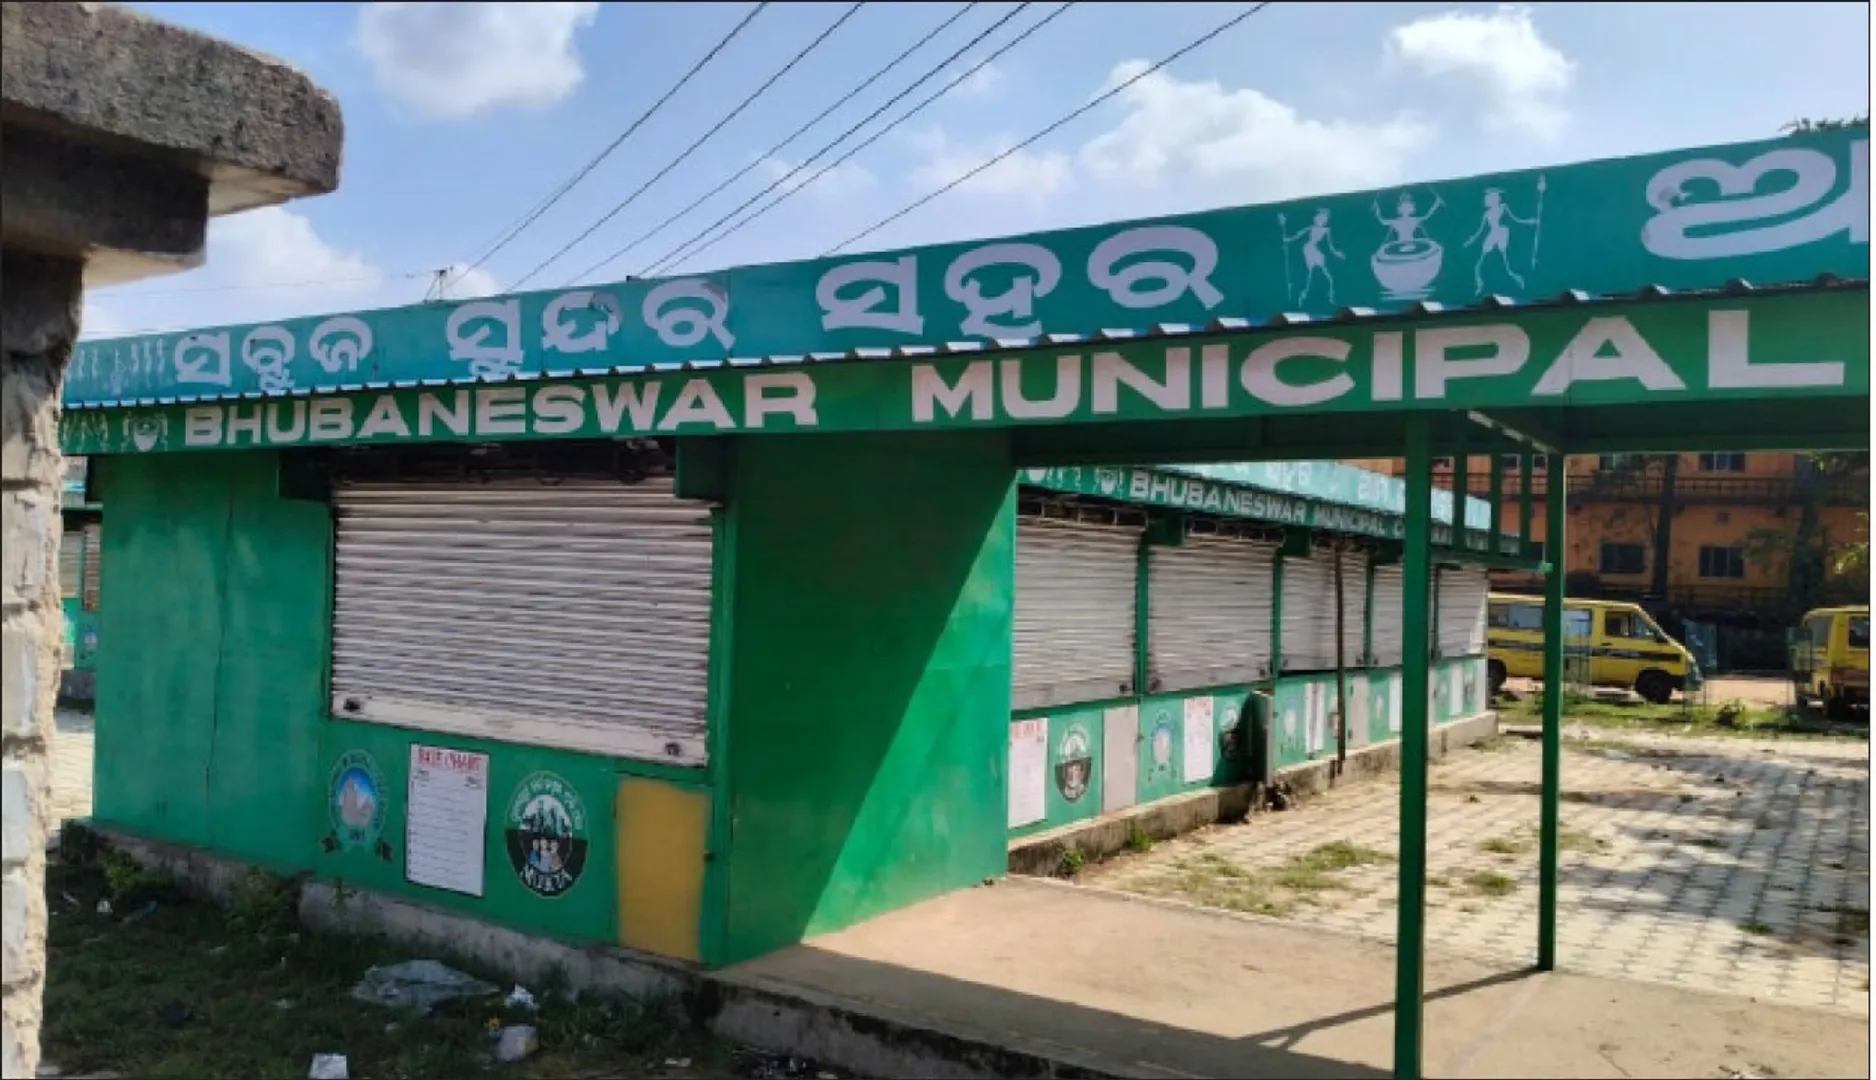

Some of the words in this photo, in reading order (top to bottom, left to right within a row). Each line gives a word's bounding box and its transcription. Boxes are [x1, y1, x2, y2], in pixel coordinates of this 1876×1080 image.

[174, 317, 373, 391] ସବୁଜ
[815, 225, 1224, 339] ସହର
[184, 371, 819, 447] BHUBANESWAR
[911, 309, 1845, 422] MUNICIPAL
[1130, 470, 1306, 523] BHUBANESWAR
